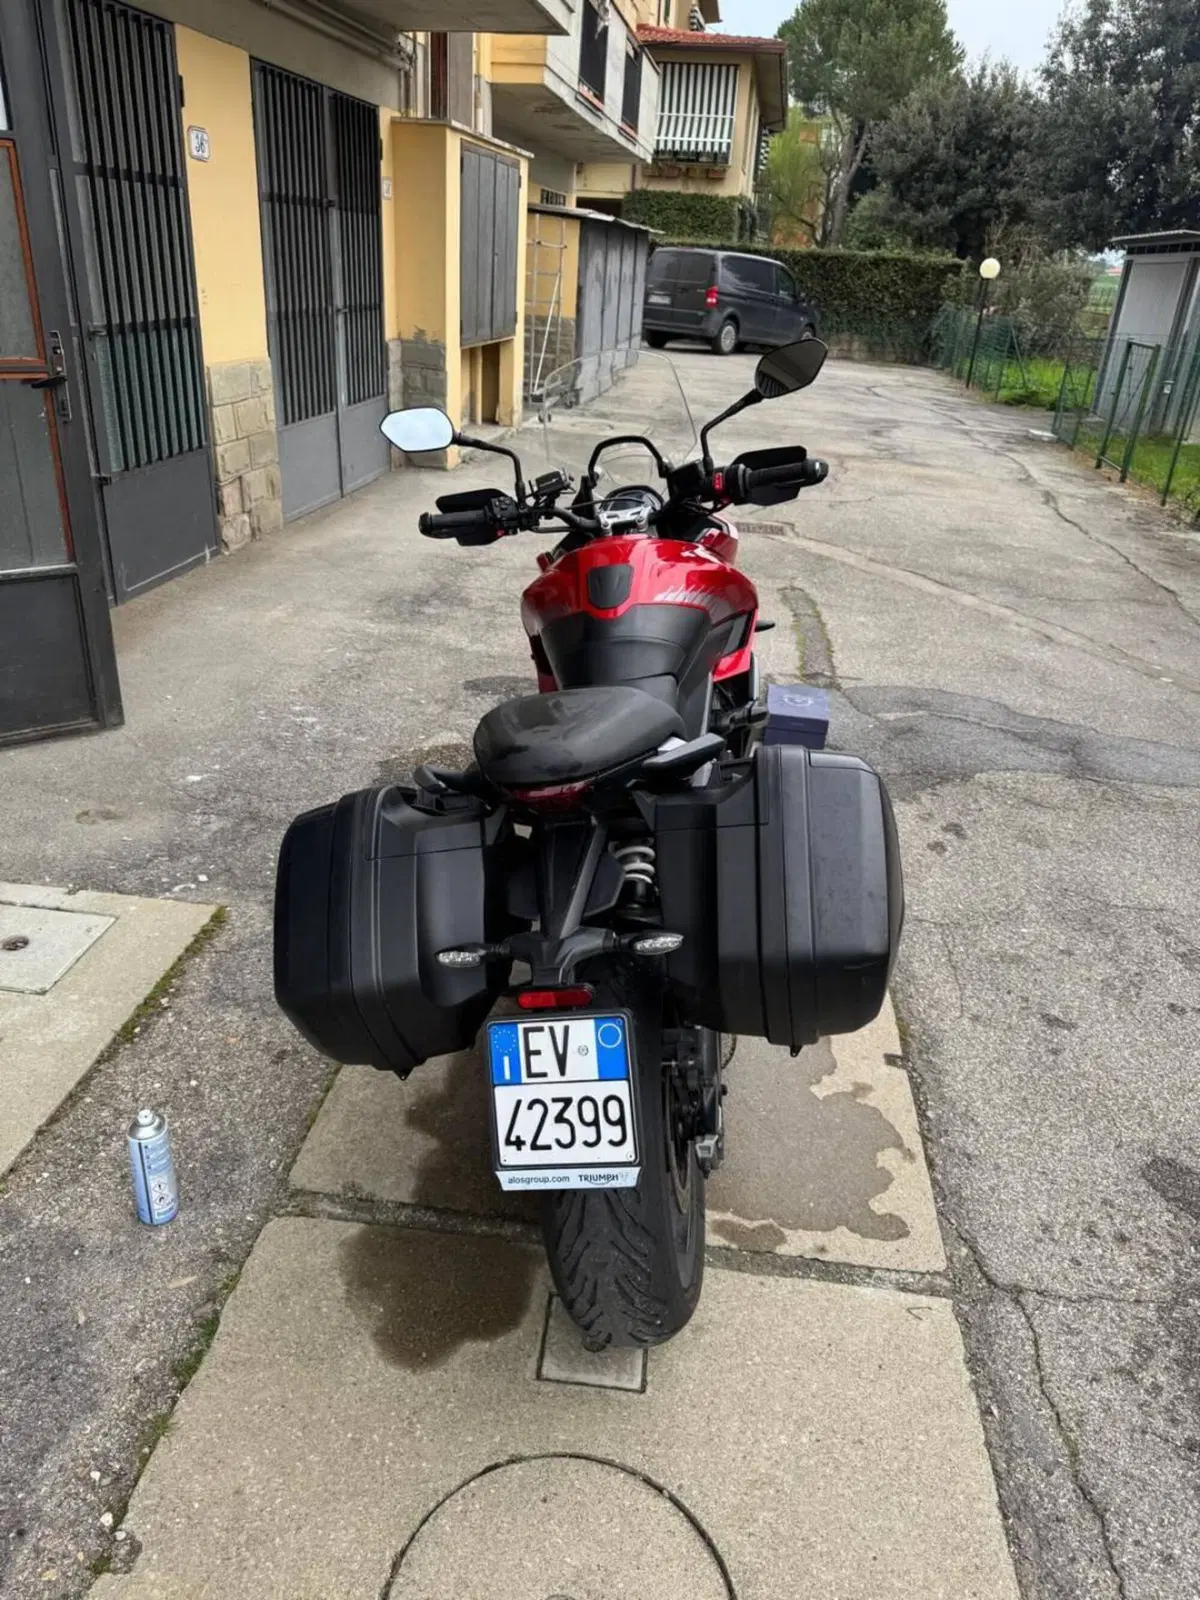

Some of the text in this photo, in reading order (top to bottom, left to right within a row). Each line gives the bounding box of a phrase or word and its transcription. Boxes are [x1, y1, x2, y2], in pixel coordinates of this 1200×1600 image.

[523, 1024, 570, 1079] EV
[504, 1094, 628, 1151] 42399
[507, 1173, 619, 1186] alosgroup.com TRIUMPH
